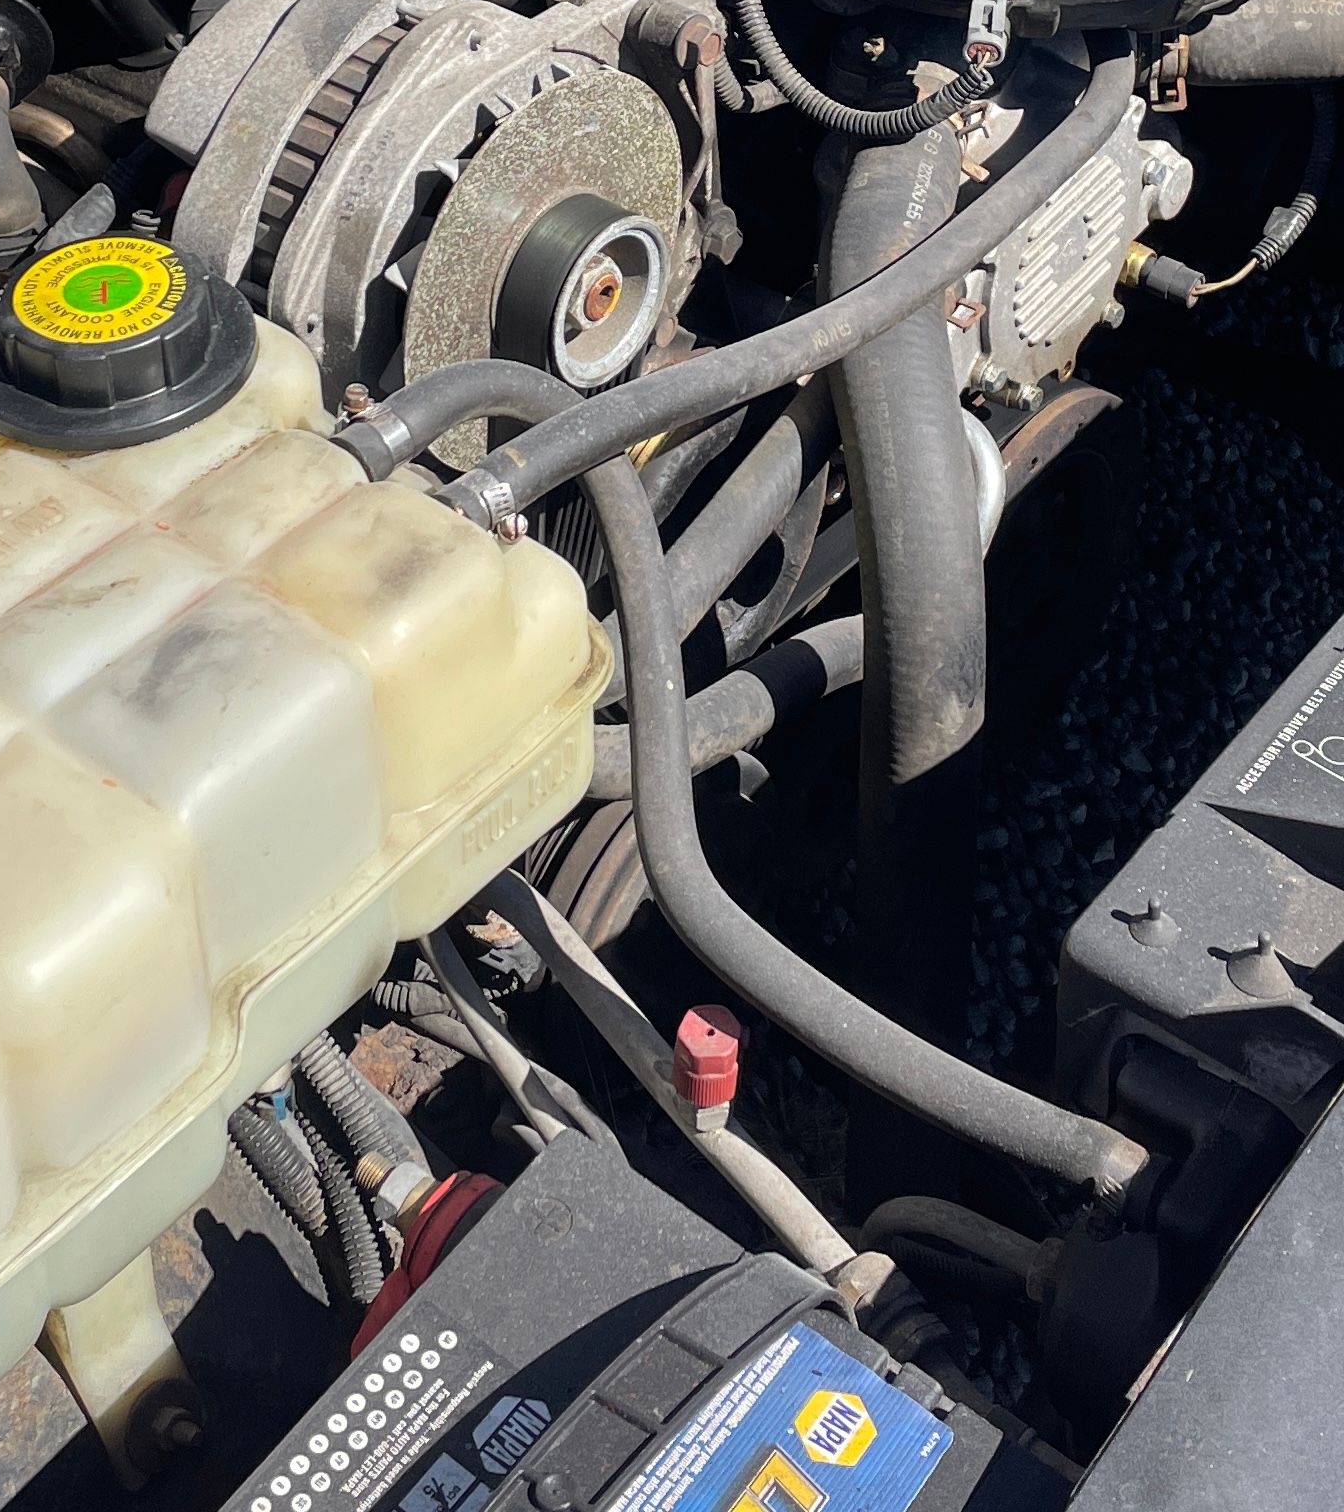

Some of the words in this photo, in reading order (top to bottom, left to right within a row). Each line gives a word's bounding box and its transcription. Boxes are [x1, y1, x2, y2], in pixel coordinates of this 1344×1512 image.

[96, 240, 155, 255] REMOVE
[39, 245, 92, 274] SLOWLY
[116, 253, 141, 265] PSI
[141, 261, 156, 272] 15
[46, 252, 112, 289] PRESSURE
[22, 277, 36, 298] HOT
[160, 264, 188, 312] CAUTION
[121, 281, 161, 319] ENGINE
[21, 299, 47, 325] WHEN
[45, 299, 115, 325] COOLANT
[141, 311, 163, 327] DO
[43, 320, 103, 340] REMOVE
[108, 322, 139, 338] NOT
[1235, 740, 1285, 793] ACCESSORY
[1277, 713, 1308, 741] DRIVE
[1300, 689, 1327, 714] BELT
[460, 802, 518, 867] FULL
[441, 1334, 453, 1345] JA
[424, 1353, 436, 1365] FE
[752, 1355, 770, 1374] lead
[758, 1337, 799, 1384] PROPOSITION
[405, 1373, 418, 1386] MA
[465, 1359, 493, 1390] Recycle
[741, 1370, 758, 1388] and
[388, 1392, 401, 1406] AP
[418, 1377, 444, 1406] nearest
[434, 1387, 450, 1404] For
[729, 1384, 747, 1404] lead
[403, 1402, 421, 1422] you,
[424, 1400, 439, 1415] the
[369, 1412, 383, 1426] MY
[391, 1419, 408, 1436] call
[407, 1412, 428, 1435] NAPA
[808, 1398, 863, 1456] NAPA
[351, 1432, 364, 1446] JU
[389, 1432, 411, 1455] AUTO
[483, 1406, 544, 1470] NAPA
[704, 1426, 731, 1455] Battery
[368, 1452, 392, 1479] PARTS
[399, 1454, 411, 1465] in
[667, 1443, 702, 1483] chemicals
[314, 1475, 327, 1489] AU
[384, 1462, 404, 1483] used
[350, 1475, 371, 1499] store
[421, 1476, 443, 1499] 75
[445, 1484, 461, 1501] BCI
[642, 1476, 661, 1496] also
[649, 1479, 674, 1507] known
[294, 1496, 308, 1510] SE
